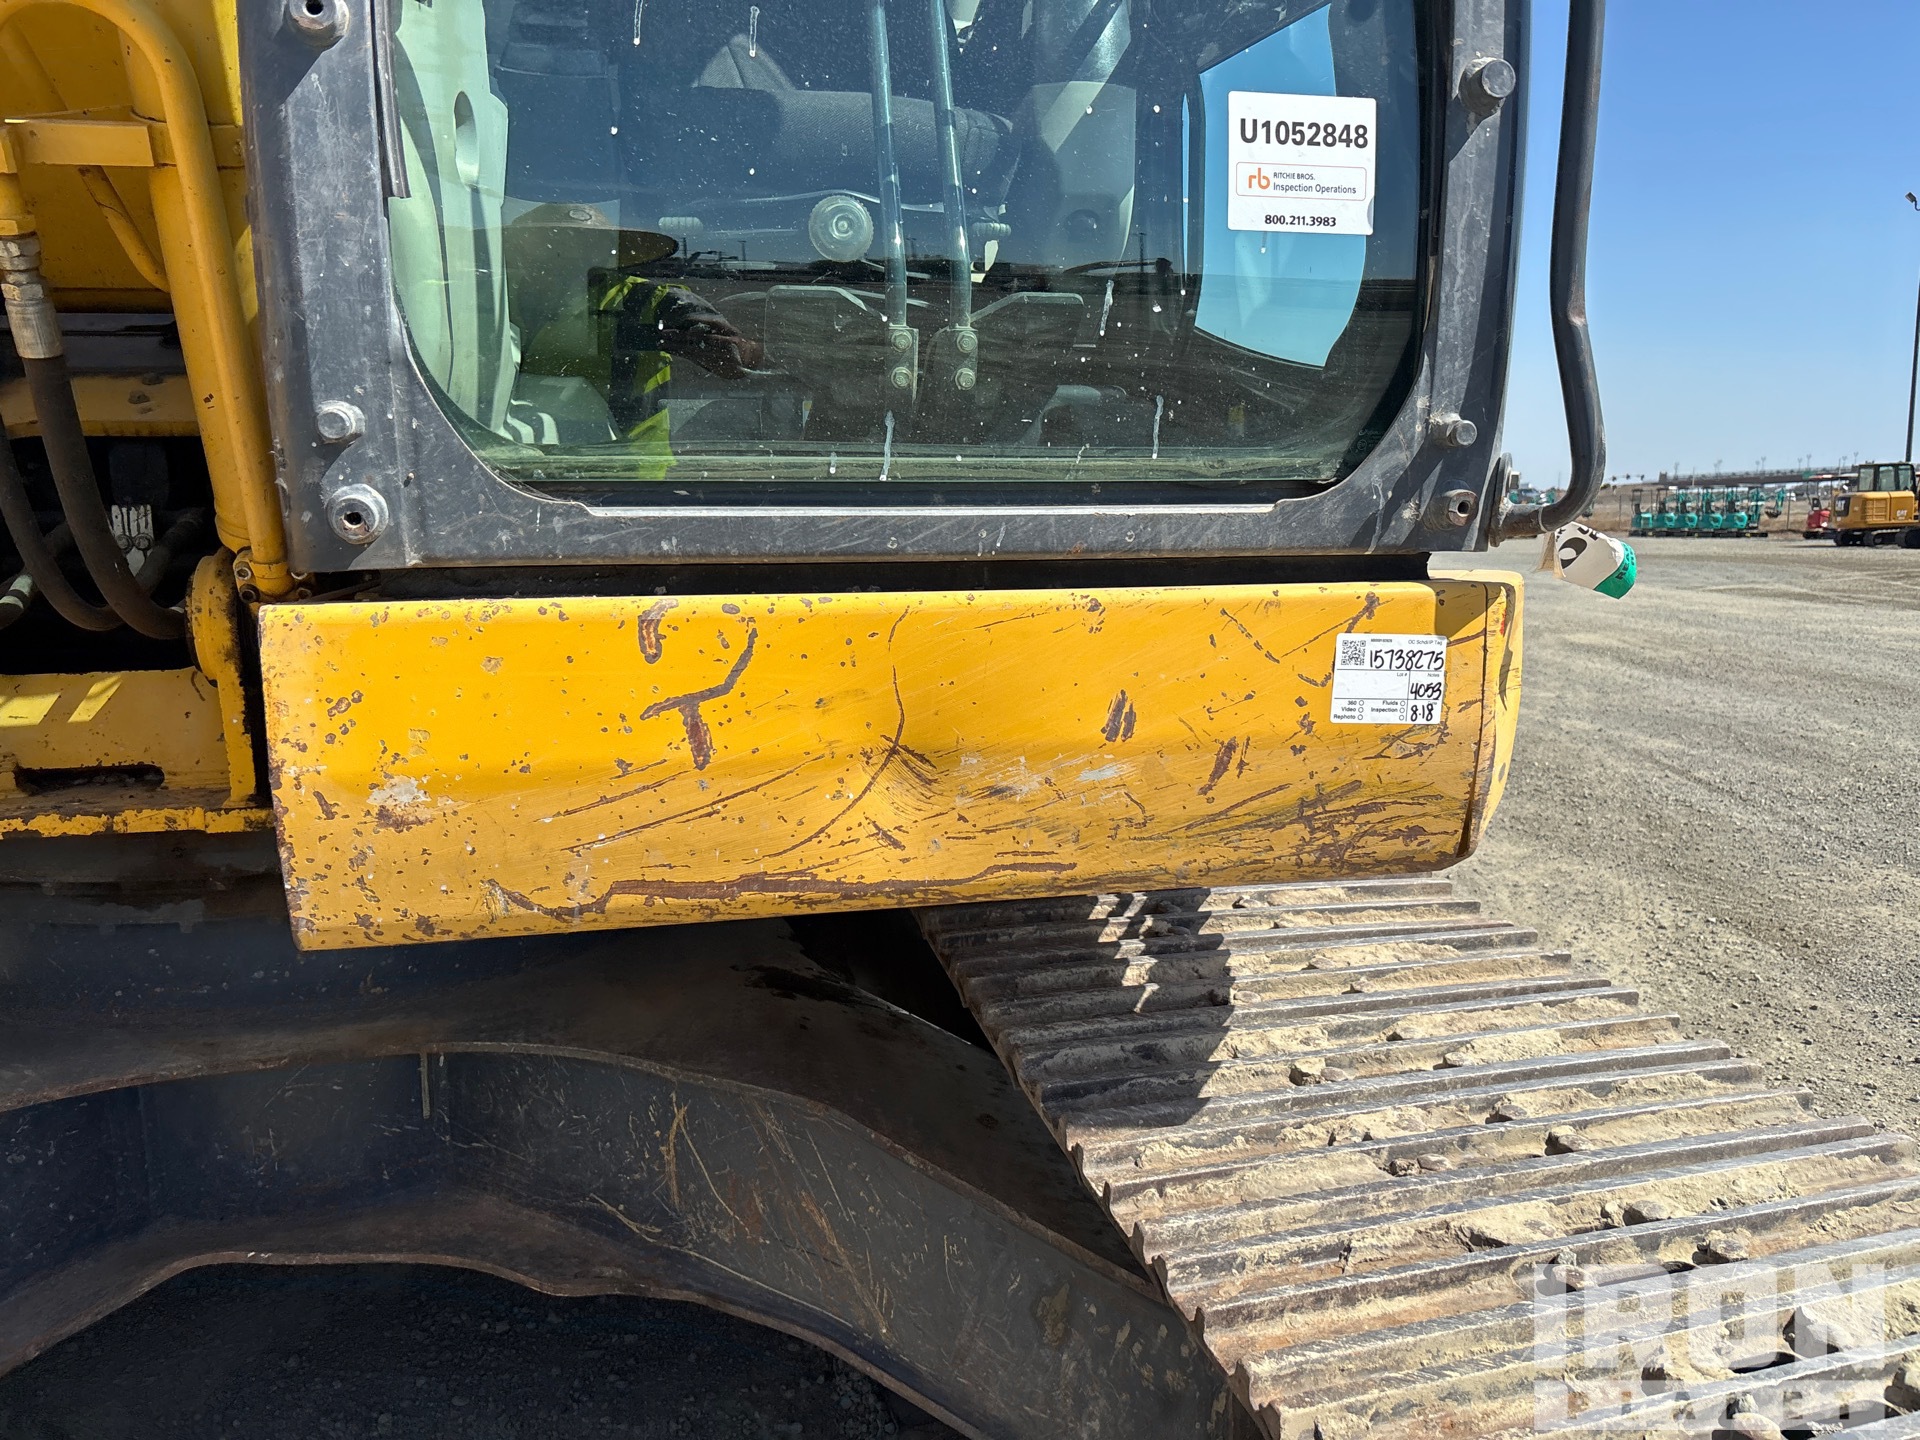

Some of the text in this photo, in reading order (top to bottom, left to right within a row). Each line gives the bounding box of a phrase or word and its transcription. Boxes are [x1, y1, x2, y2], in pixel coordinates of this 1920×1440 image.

[1240, 117, 1368, 149] U1052848
[1248, 167, 1271, 190] rb
[1273, 172, 1316, 181] RITCHIE BROS.
[1273, 182, 1357, 194] Inspection Operations
[1264, 214, 1337, 227] 800.211.3983
[1369, 649, 1444, 671] 15738275
[1410, 682, 1442, 700] 4053
